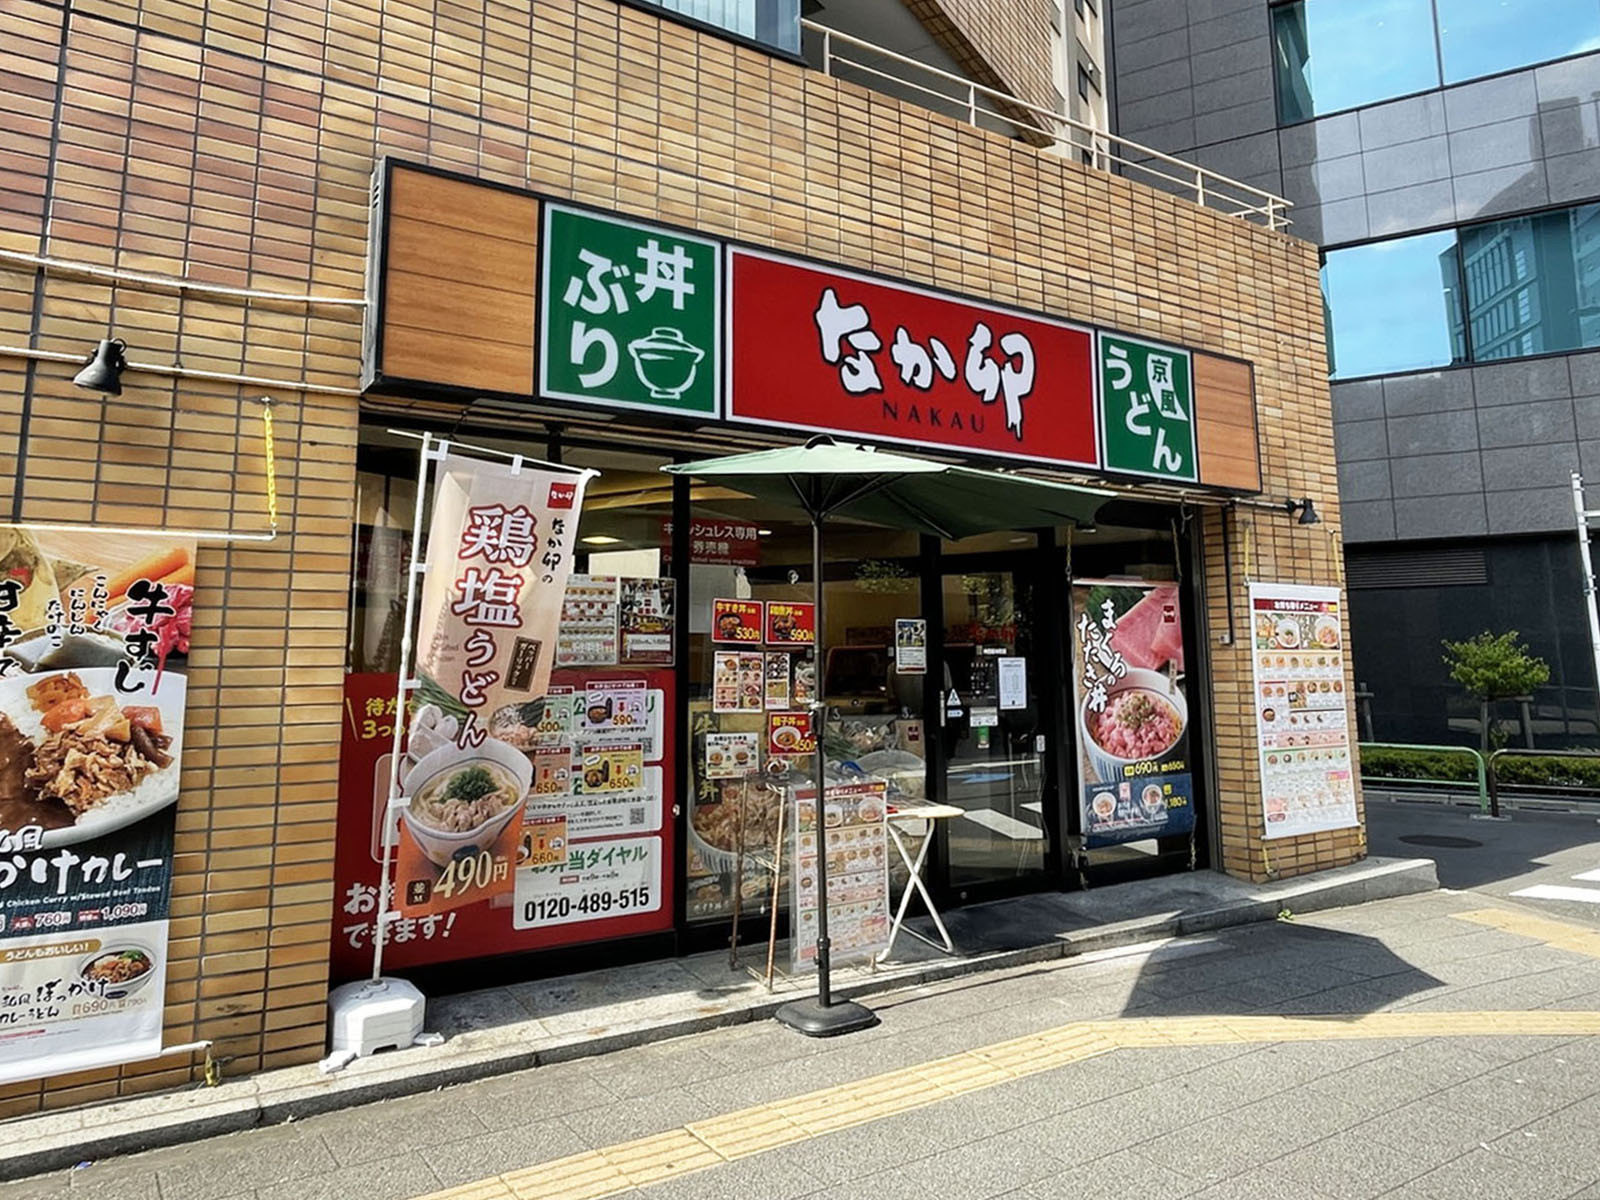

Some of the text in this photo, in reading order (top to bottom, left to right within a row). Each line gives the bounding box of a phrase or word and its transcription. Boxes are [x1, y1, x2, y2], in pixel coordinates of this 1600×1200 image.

[815, 287, 1036, 441] なか卯
[1151, 357, 1177, 416] 京風
[882, 399, 985, 434] NAKAU
[1105, 344, 1183, 473] うどん
[541, 517, 566, 584] なか卯の
[663, 523, 757, 540] キシュレス専用
[46, 600, 65, 647] たけのこ
[69, 589, 87, 635] にんじん
[113, 580, 175, 694] 牛すじ
[452, 503, 538, 750] 鶏塩うどん
[6, 898, 41, 908] Chicken
[43, 896, 67, 906] Curry
[113, 889, 130, 897] Beef
[133, 885, 161, 893] Tendon
[523, 886, 650, 923] 0120-489-515
